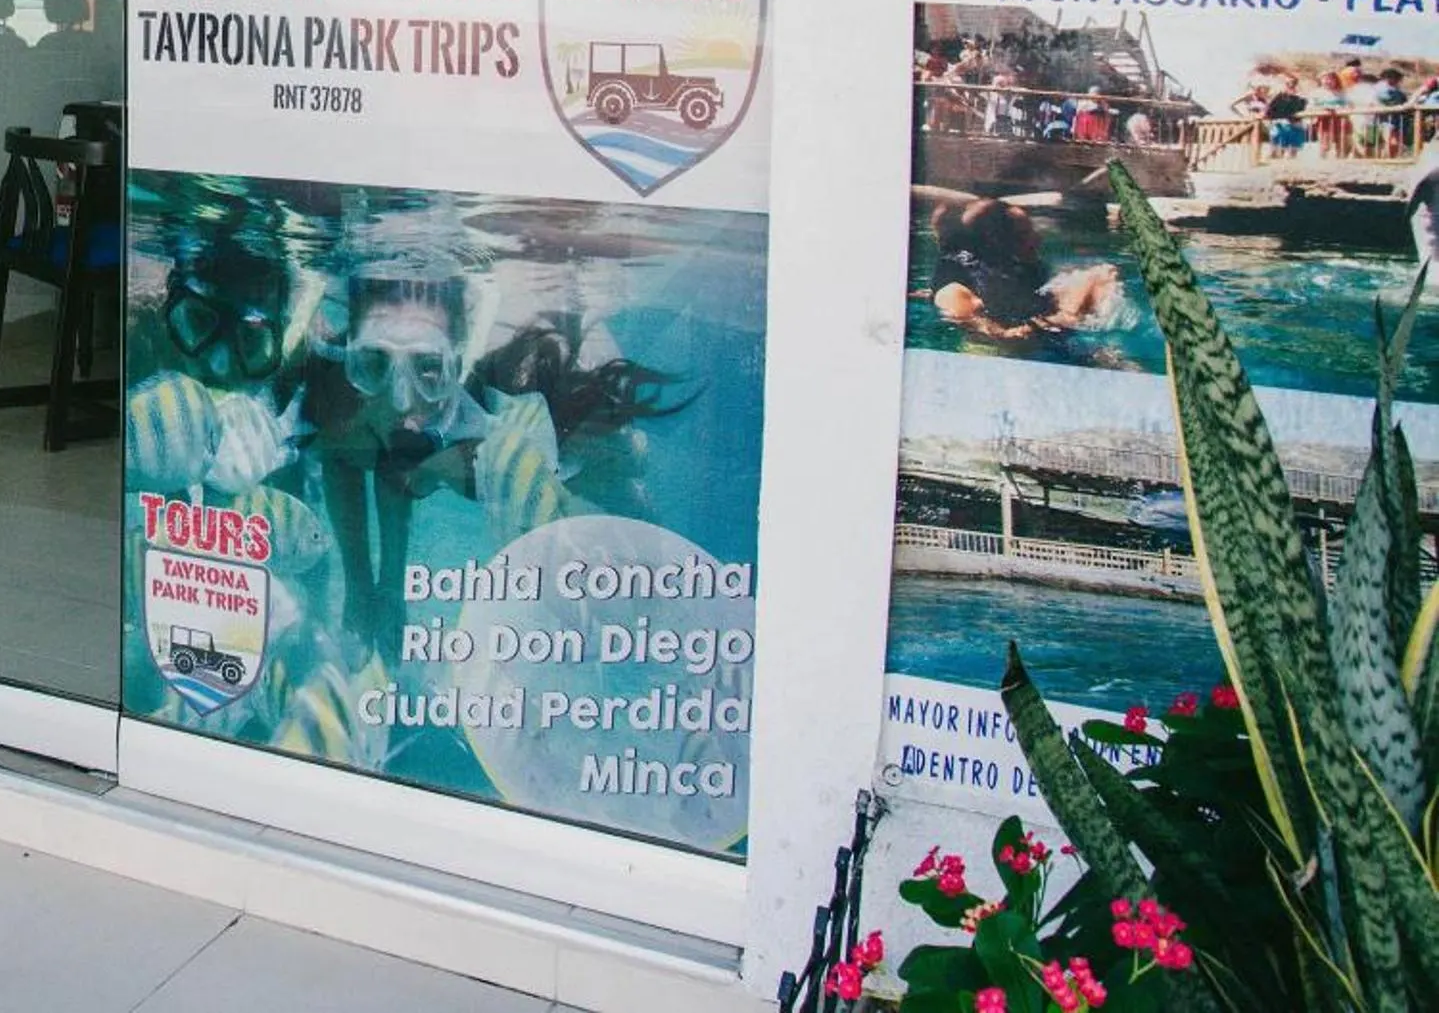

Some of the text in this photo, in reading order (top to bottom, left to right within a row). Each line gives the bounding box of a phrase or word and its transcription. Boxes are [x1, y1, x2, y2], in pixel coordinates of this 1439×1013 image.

[138, 11, 521, 78] TAYRONA PARK TRIPS
[273, 84, 363, 113] RNT 37878
[140, 493, 271, 563] TOURS
[152, 580, 259, 616] PARK TRIPS
[162, 557, 250, 592] TAYRONA
[557, 554, 754, 601] Concha
[490, 625, 584, 663] Don
[600, 616, 754, 675] Diego
[358, 684, 752, 732] Ciudad Perdida
[889, 695, 959, 732] MAYOR
[580, 748, 736, 797] Minca
